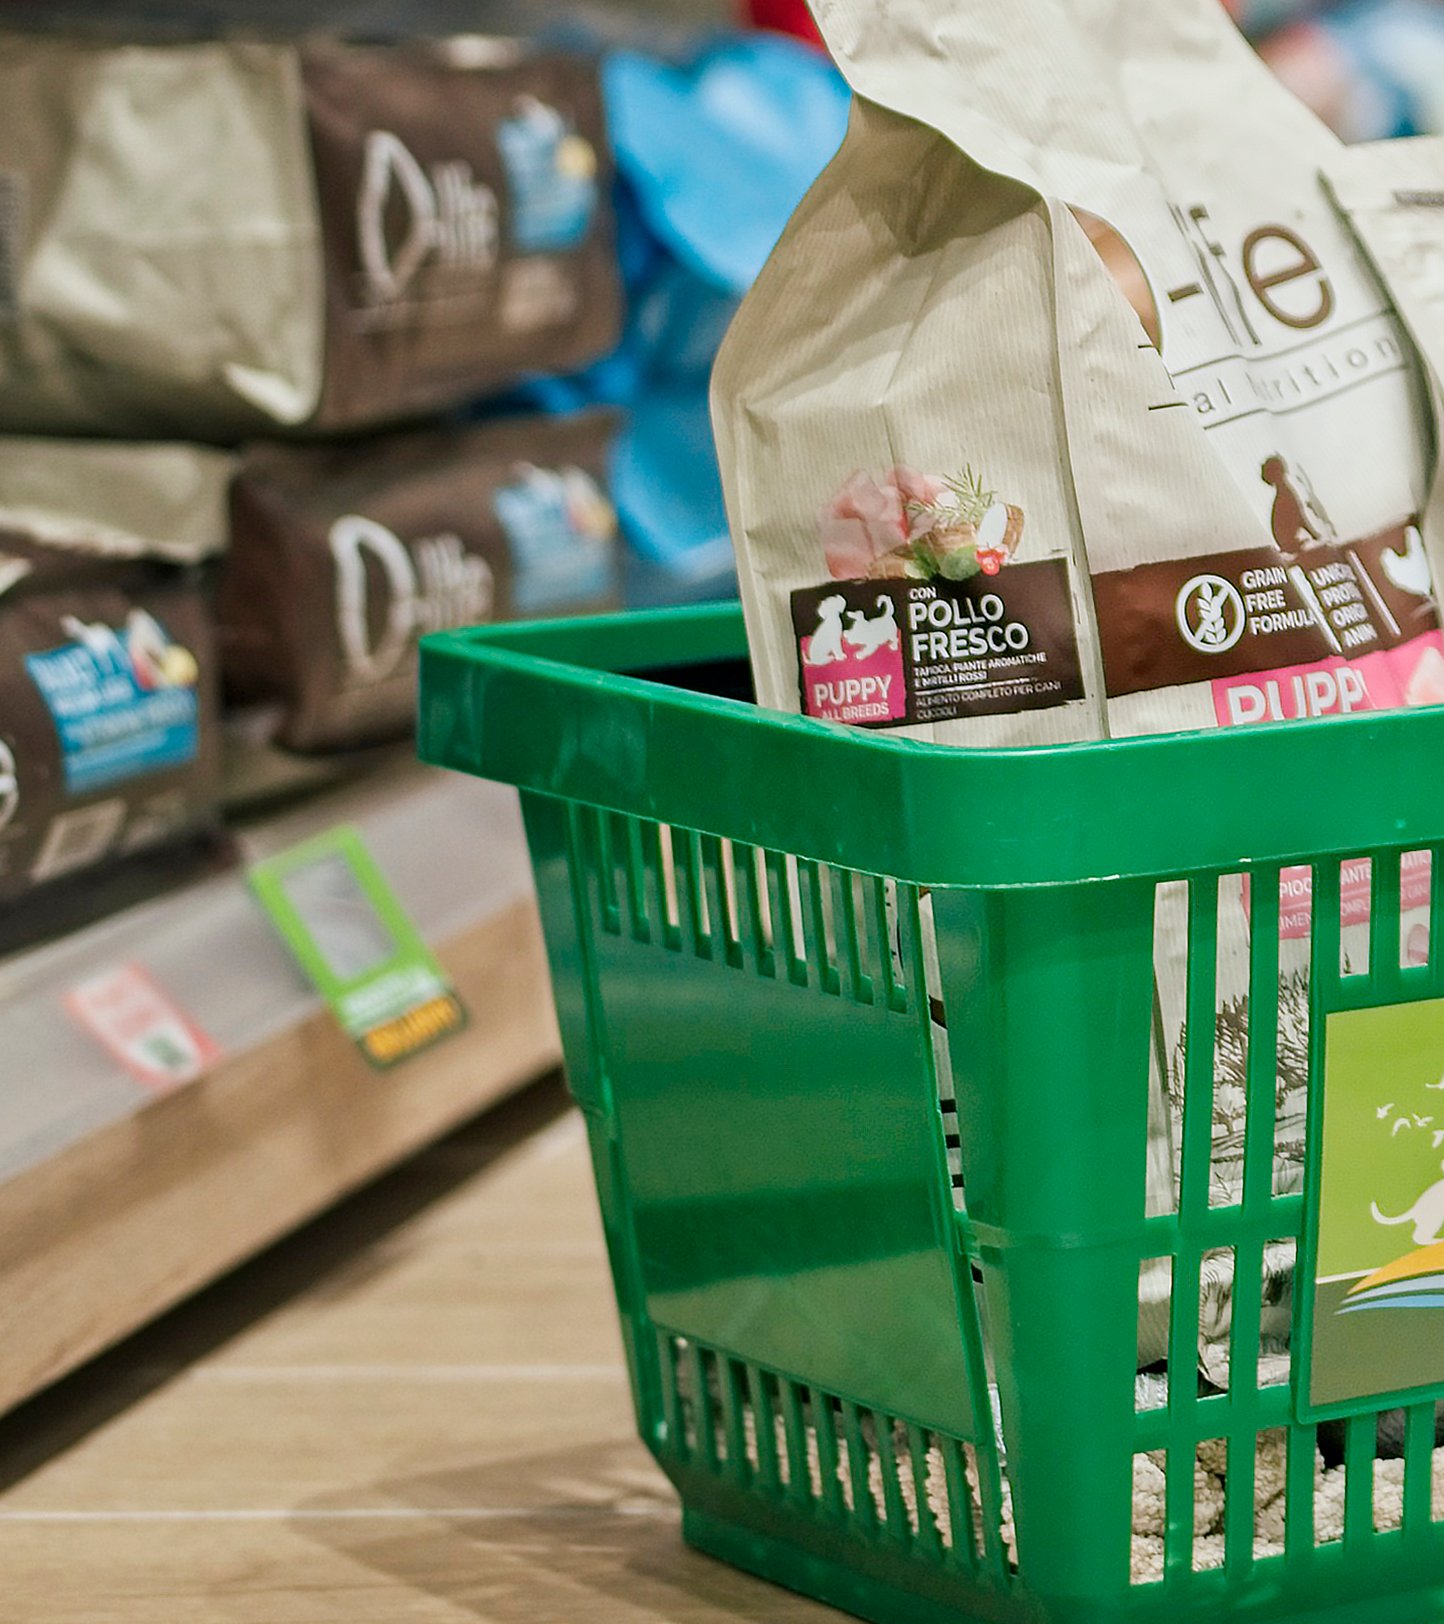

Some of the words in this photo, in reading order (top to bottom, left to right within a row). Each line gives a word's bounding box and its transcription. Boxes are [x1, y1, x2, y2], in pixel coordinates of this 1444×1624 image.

[1241, 566, 1288, 590] GRAIN
[909, 586, 936, 601] CON
[1246, 589, 1287, 613] FREE
[909, 593, 1004, 630] POLLO
[1250, 607, 1319, 636] FORMULA
[911, 622, 1029, 662] FRESCO
[814, 674, 892, 708] PUPPY
[842, 701, 889, 720] BREEDS
